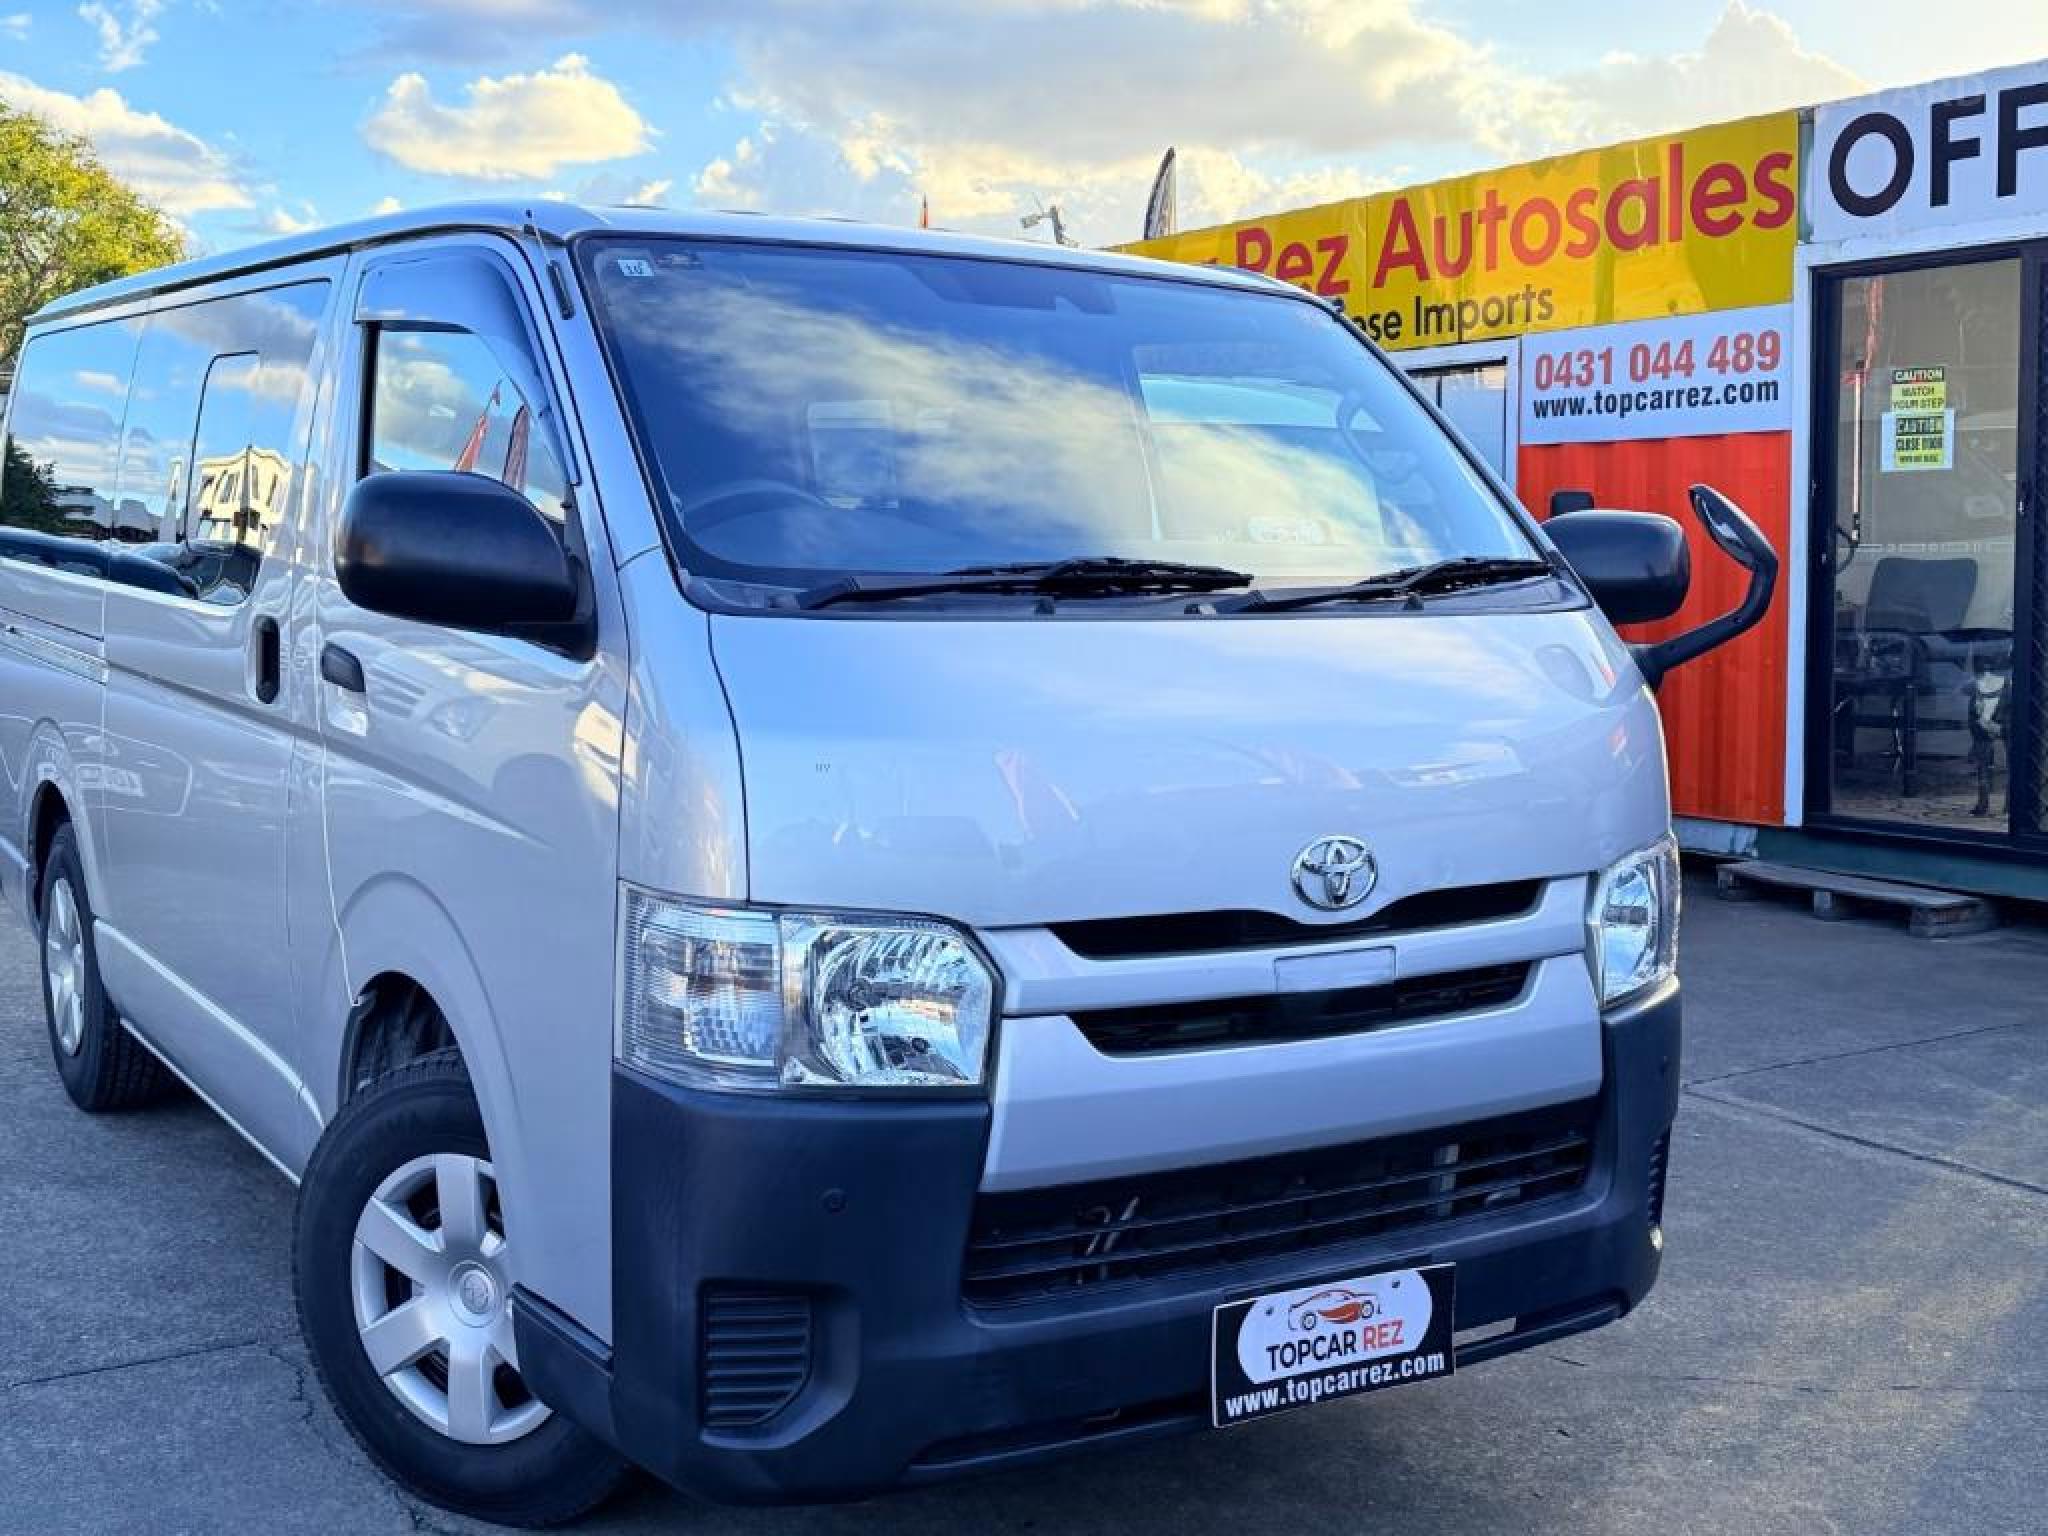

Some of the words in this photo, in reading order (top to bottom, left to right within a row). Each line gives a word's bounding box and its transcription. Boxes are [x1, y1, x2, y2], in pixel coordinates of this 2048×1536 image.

[1828, 81, 2048, 217] OFF
[1373, 143, 1795, 288] Autosales
[1415, 284, 1554, 342] Imports
[1535, 347, 1613, 390] 0431
[1629, 340, 1695, 383] 044
[1707, 330, 1781, 375] 489
[1894, 368, 1943, 381] CAUTION
[1534, 379, 1779, 418] www.topcarrez.com
[1266, 1329, 1357, 1372] TOPCAR
[1363, 1319, 1404, 1351] REZ
[1226, 1352, 1445, 1418] www.topcarrez.com
